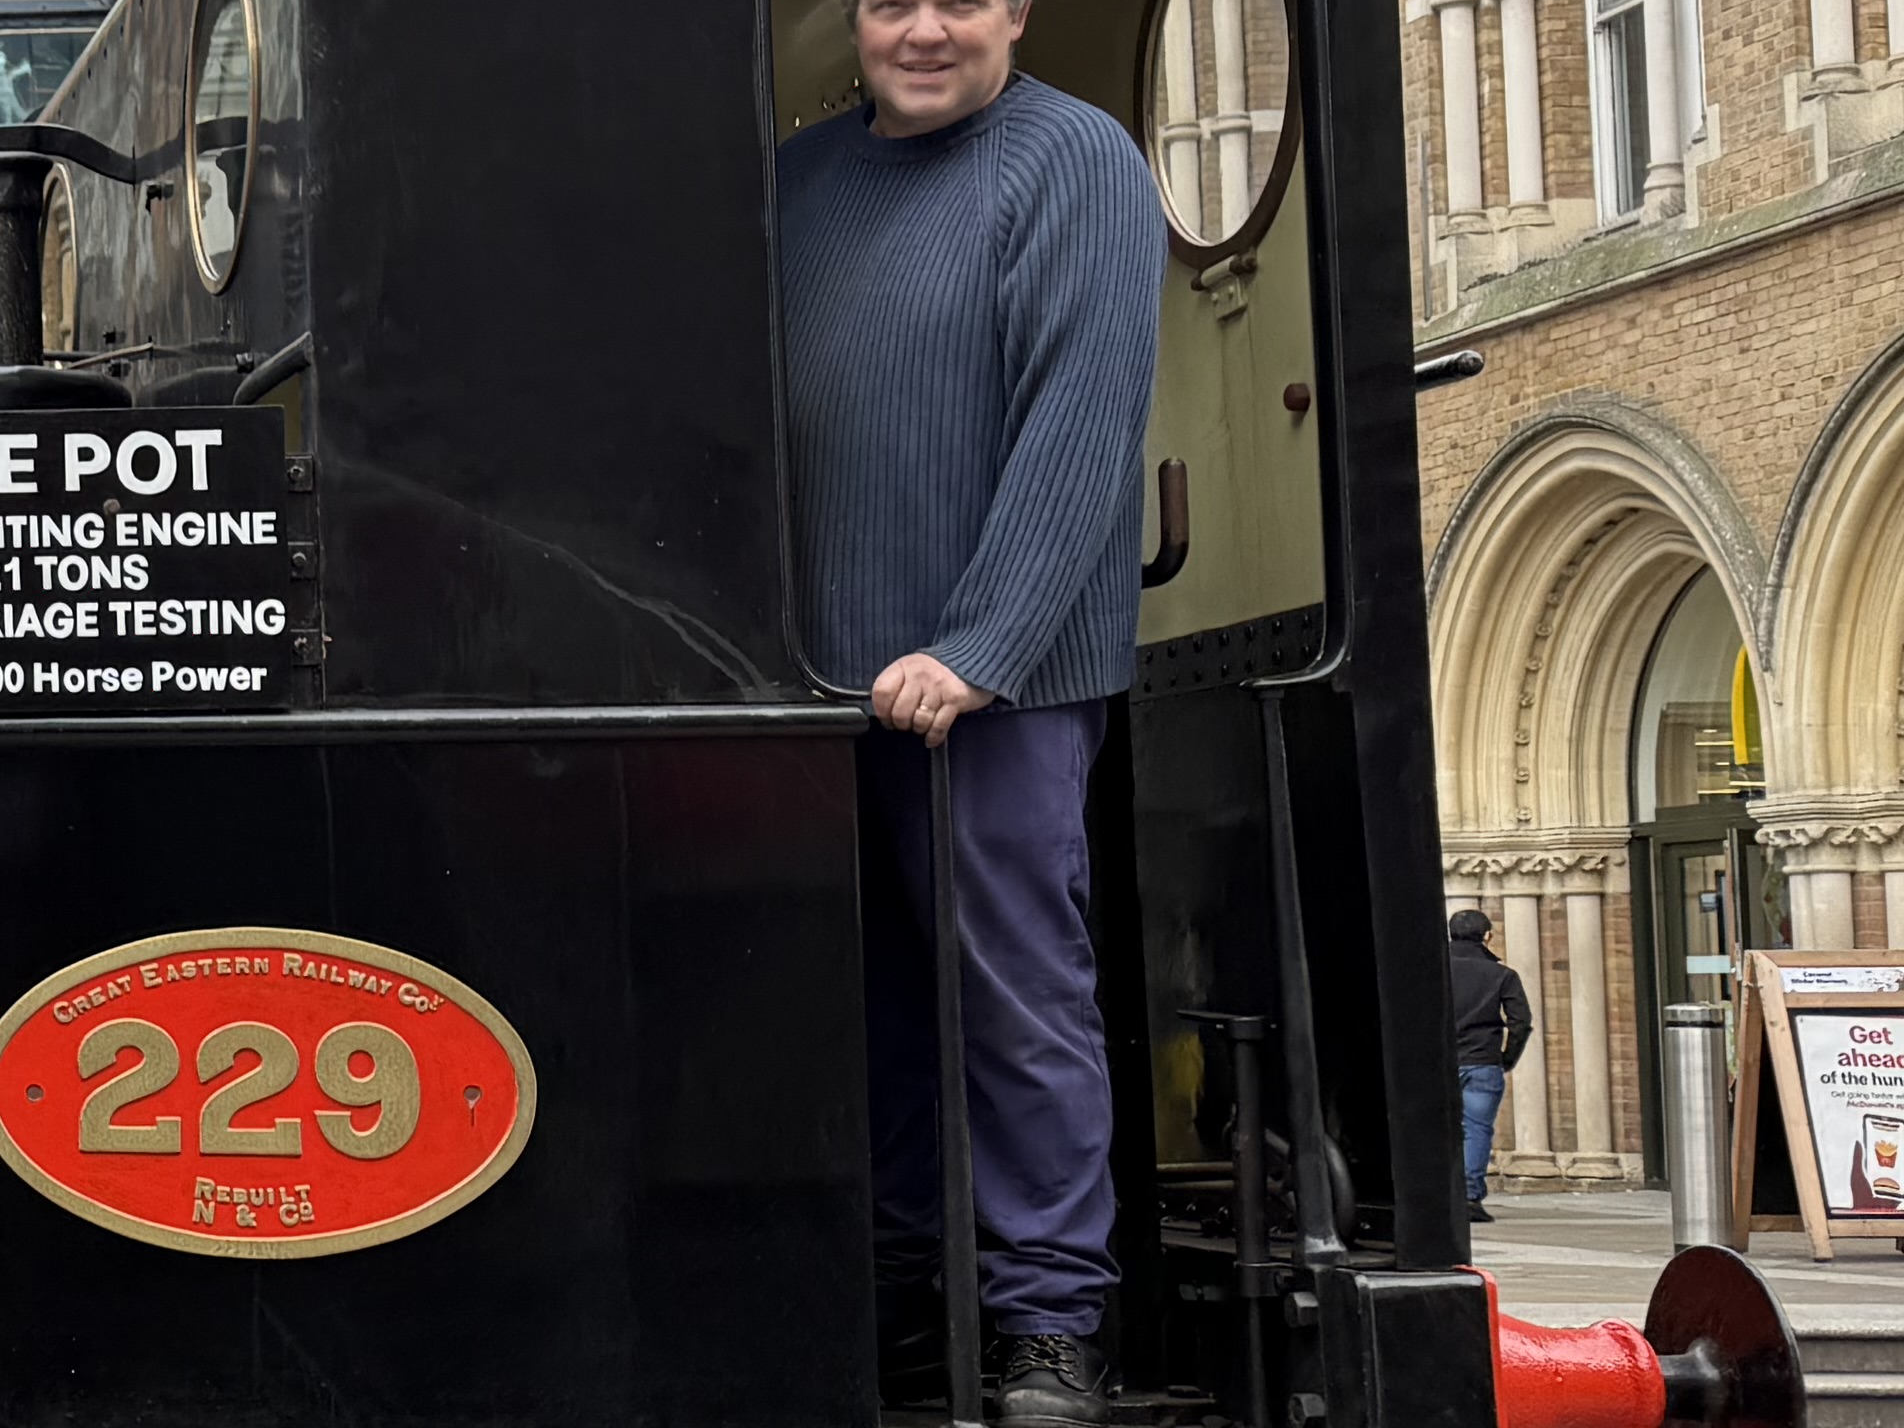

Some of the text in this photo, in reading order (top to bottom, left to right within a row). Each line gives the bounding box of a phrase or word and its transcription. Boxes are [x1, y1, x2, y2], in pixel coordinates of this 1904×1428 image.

[64, 429, 223, 492] POT
[115, 511, 279, 548] ENGINE
[42, 553, 149, 591] TONS
[109, 598, 287, 636] TESTING
[33, 662, 144, 693] Horse
[151, 661, 267, 691] Power
[1849, 1025, 1894, 1045] Get
[77, 1017, 422, 1159] 229
[1820, 1071, 1837, 1084] of
[1841, 1071, 1868, 1085] the
[192, 1199, 216, 1225] N
[236, 1203, 258, 1227] &
